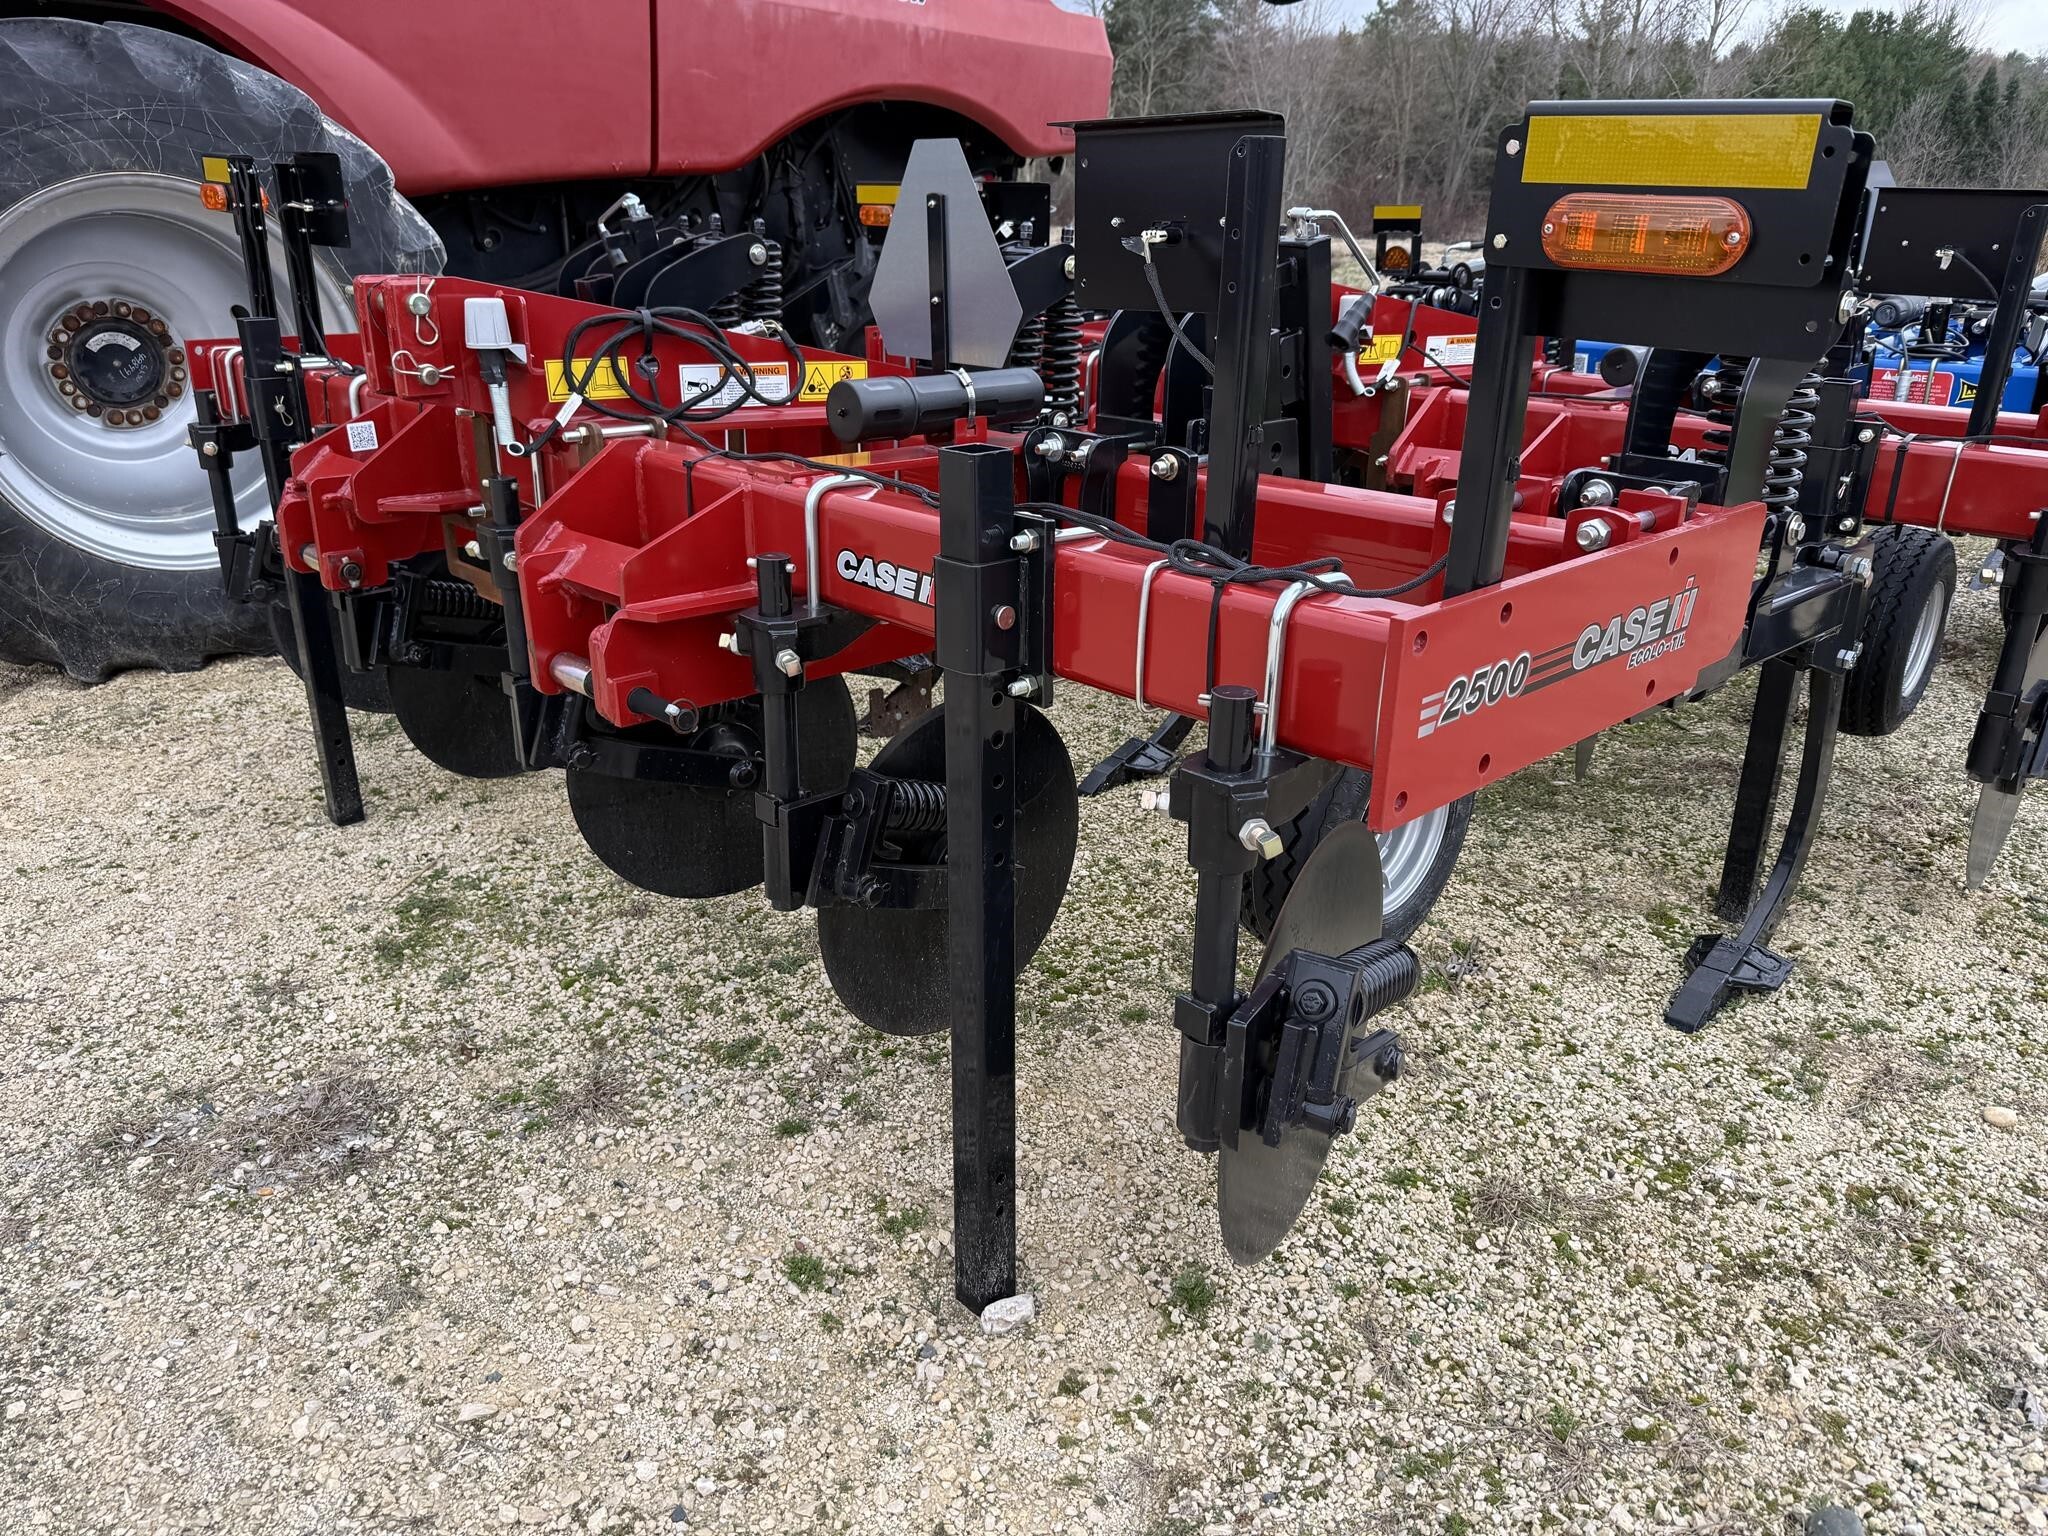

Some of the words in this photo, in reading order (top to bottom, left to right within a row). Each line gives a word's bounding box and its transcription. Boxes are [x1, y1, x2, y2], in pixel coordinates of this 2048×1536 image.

[739, 367, 780, 376] WRNING
[836, 549, 918, 601] CASE
[1571, 597, 1670, 671] CASE
[1626, 631, 1686, 670] ECOLO-TIL
[1436, 650, 1532, 728] 2500
